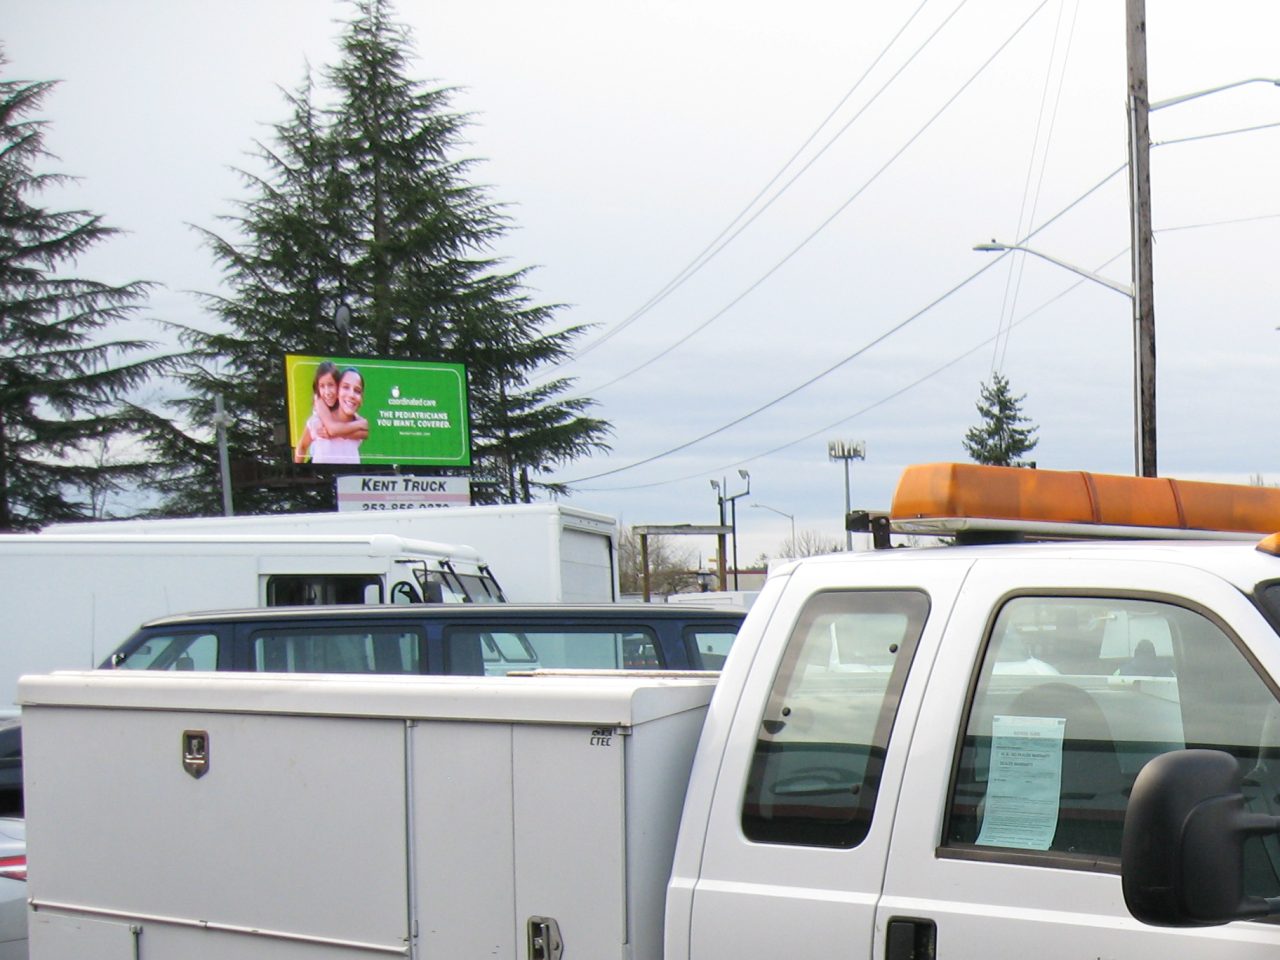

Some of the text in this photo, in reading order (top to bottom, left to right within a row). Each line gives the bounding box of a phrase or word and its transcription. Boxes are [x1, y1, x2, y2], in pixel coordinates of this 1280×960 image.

[379, 410, 448, 420] THE PEDIATRICIANS
[377, 418, 451, 428] YOU WANT, COVERED.
[361, 478, 447, 492] KENT TRUCK
